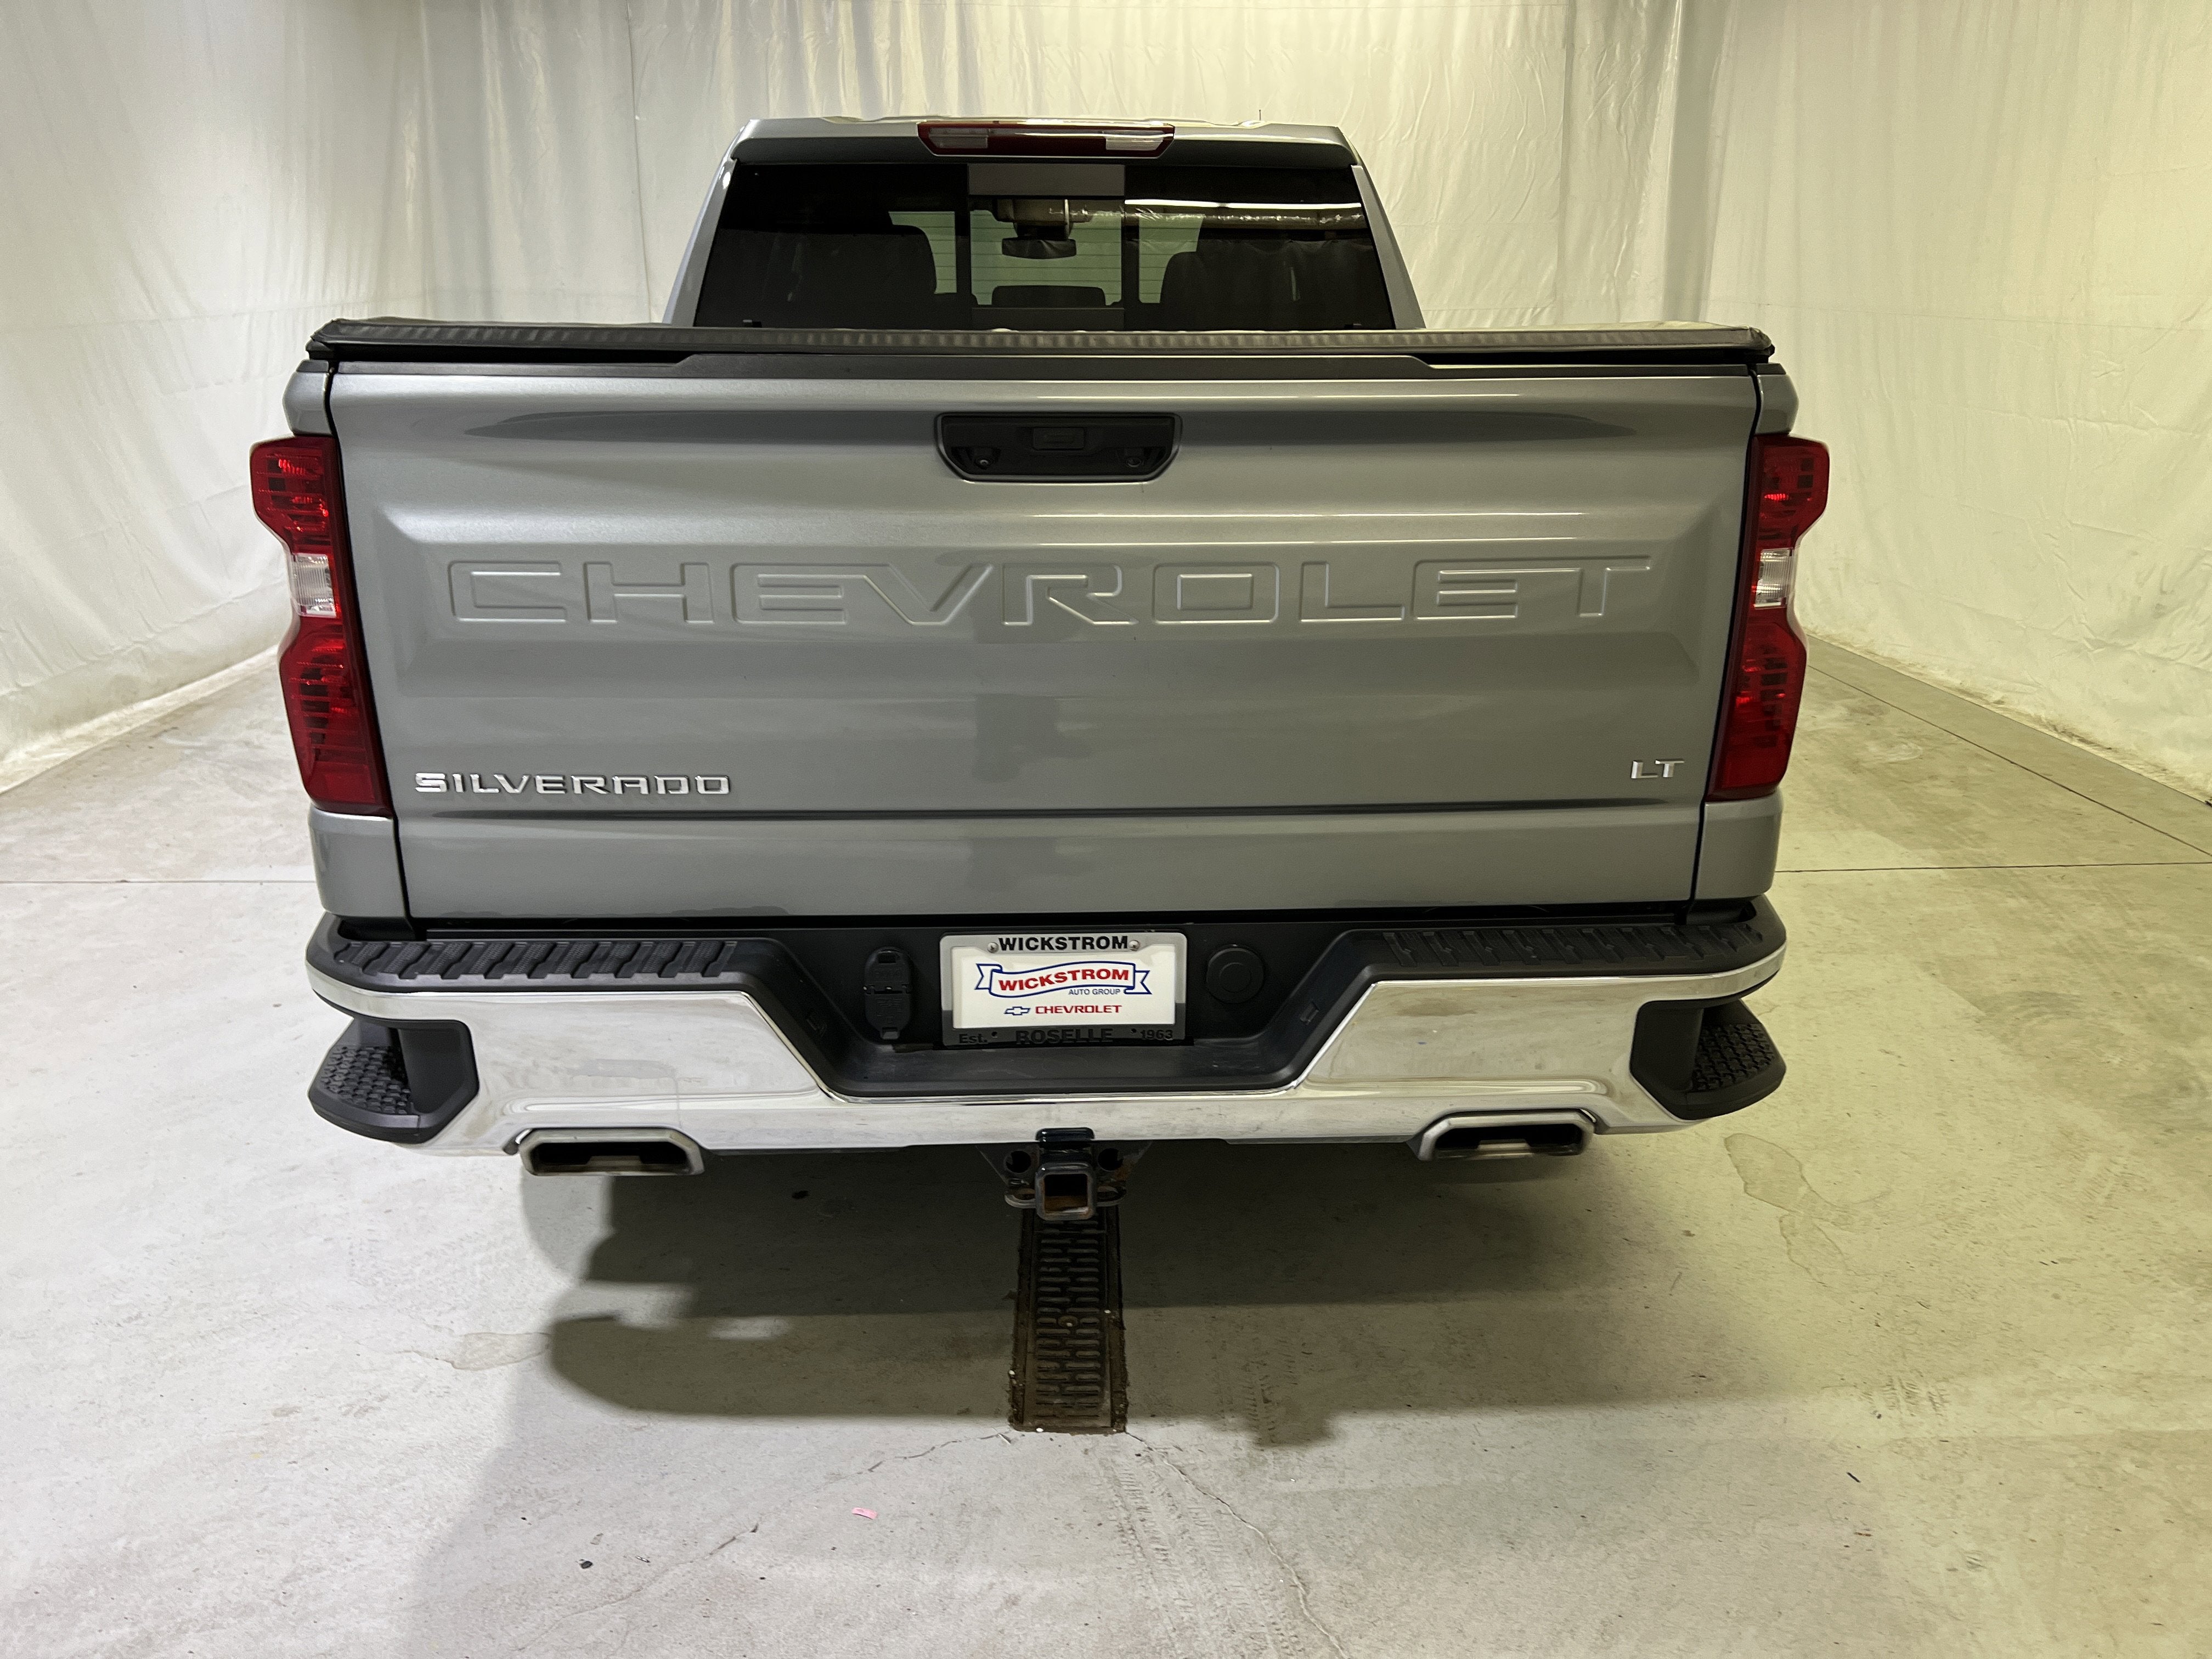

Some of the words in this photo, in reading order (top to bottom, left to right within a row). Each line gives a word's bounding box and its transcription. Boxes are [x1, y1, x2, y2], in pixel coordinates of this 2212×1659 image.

[447, 554, 1651, 627] CHEVROLET
[1630, 759, 1685, 779] LT
[415, 772, 731, 795] SILVERADO
[998, 935, 1128, 951] WICKSTROM
[997, 968, 1130, 991] WICKSTROM
[1035, 1005, 1122, 1014] CHEVROLET
[958, 1033, 988, 1045] Est.
[1015, 1028, 1114, 1045] ROSELLE
[1140, 1029, 1174, 1041] 1963
